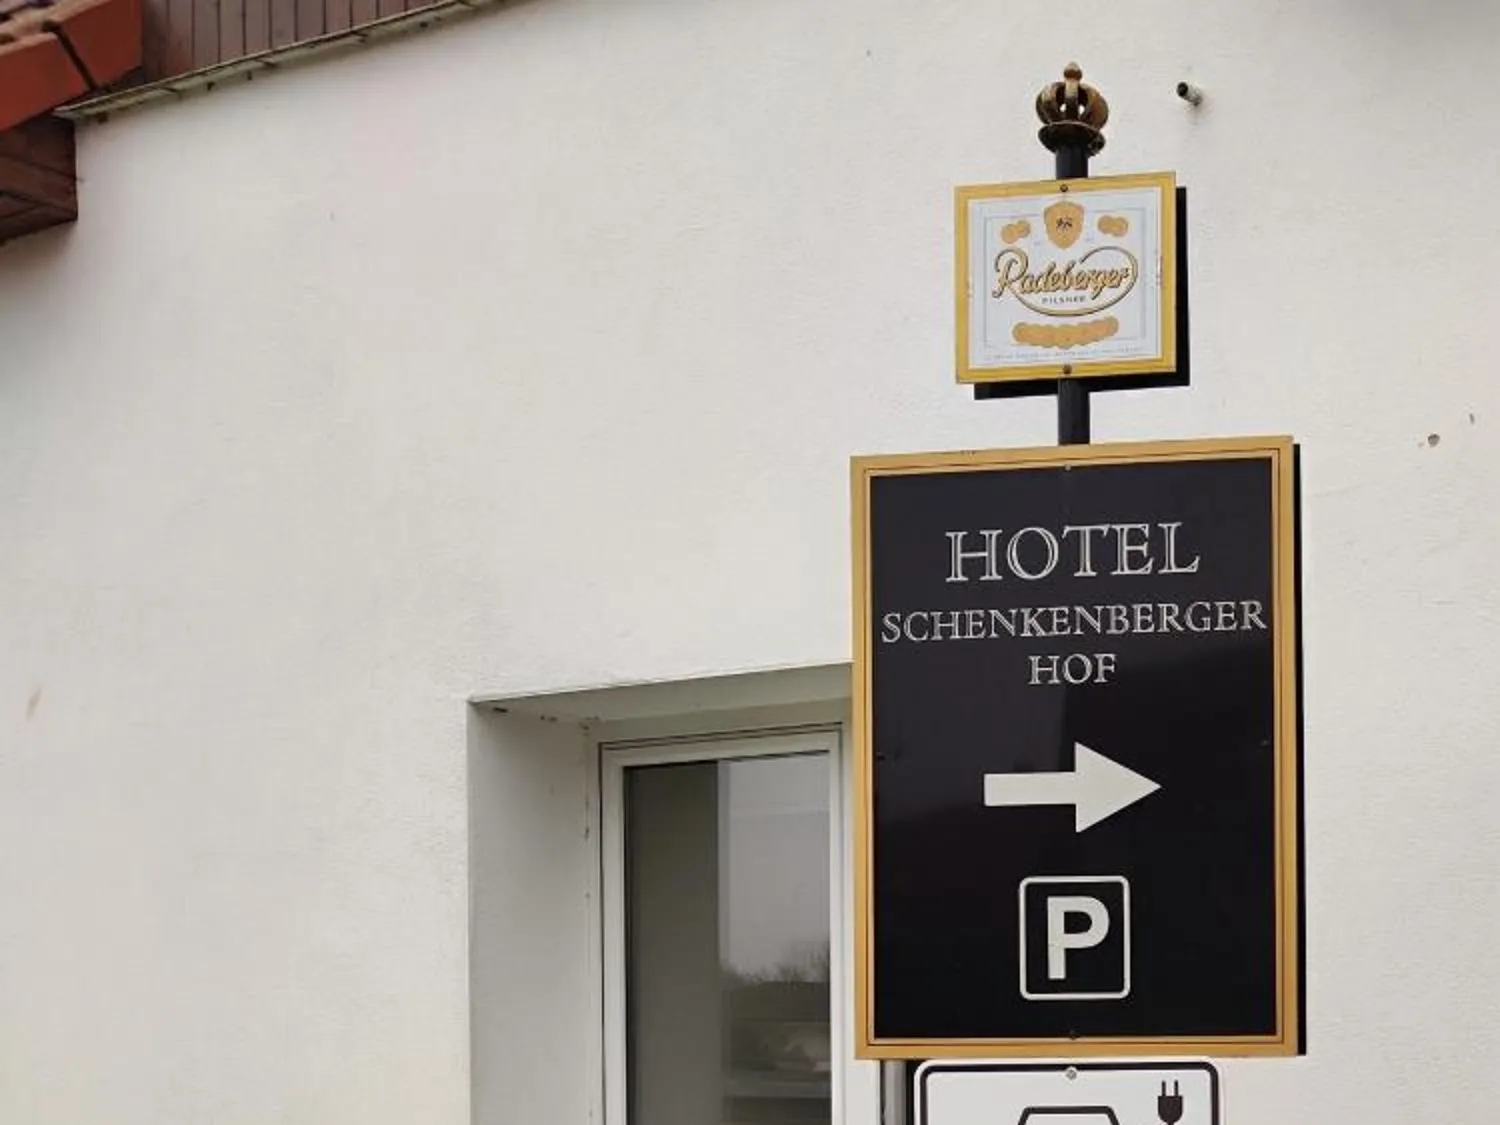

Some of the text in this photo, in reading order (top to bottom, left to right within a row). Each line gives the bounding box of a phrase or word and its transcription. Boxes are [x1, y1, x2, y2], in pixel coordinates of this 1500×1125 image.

[991, 246, 1132, 301] Radeberger
[945, 521, 1201, 583] HOTEL
[880, 600, 1268, 643] SCHENKENBERGER
[1027, 653, 1118, 685] HOF
[1047, 895, 1111, 980] P
